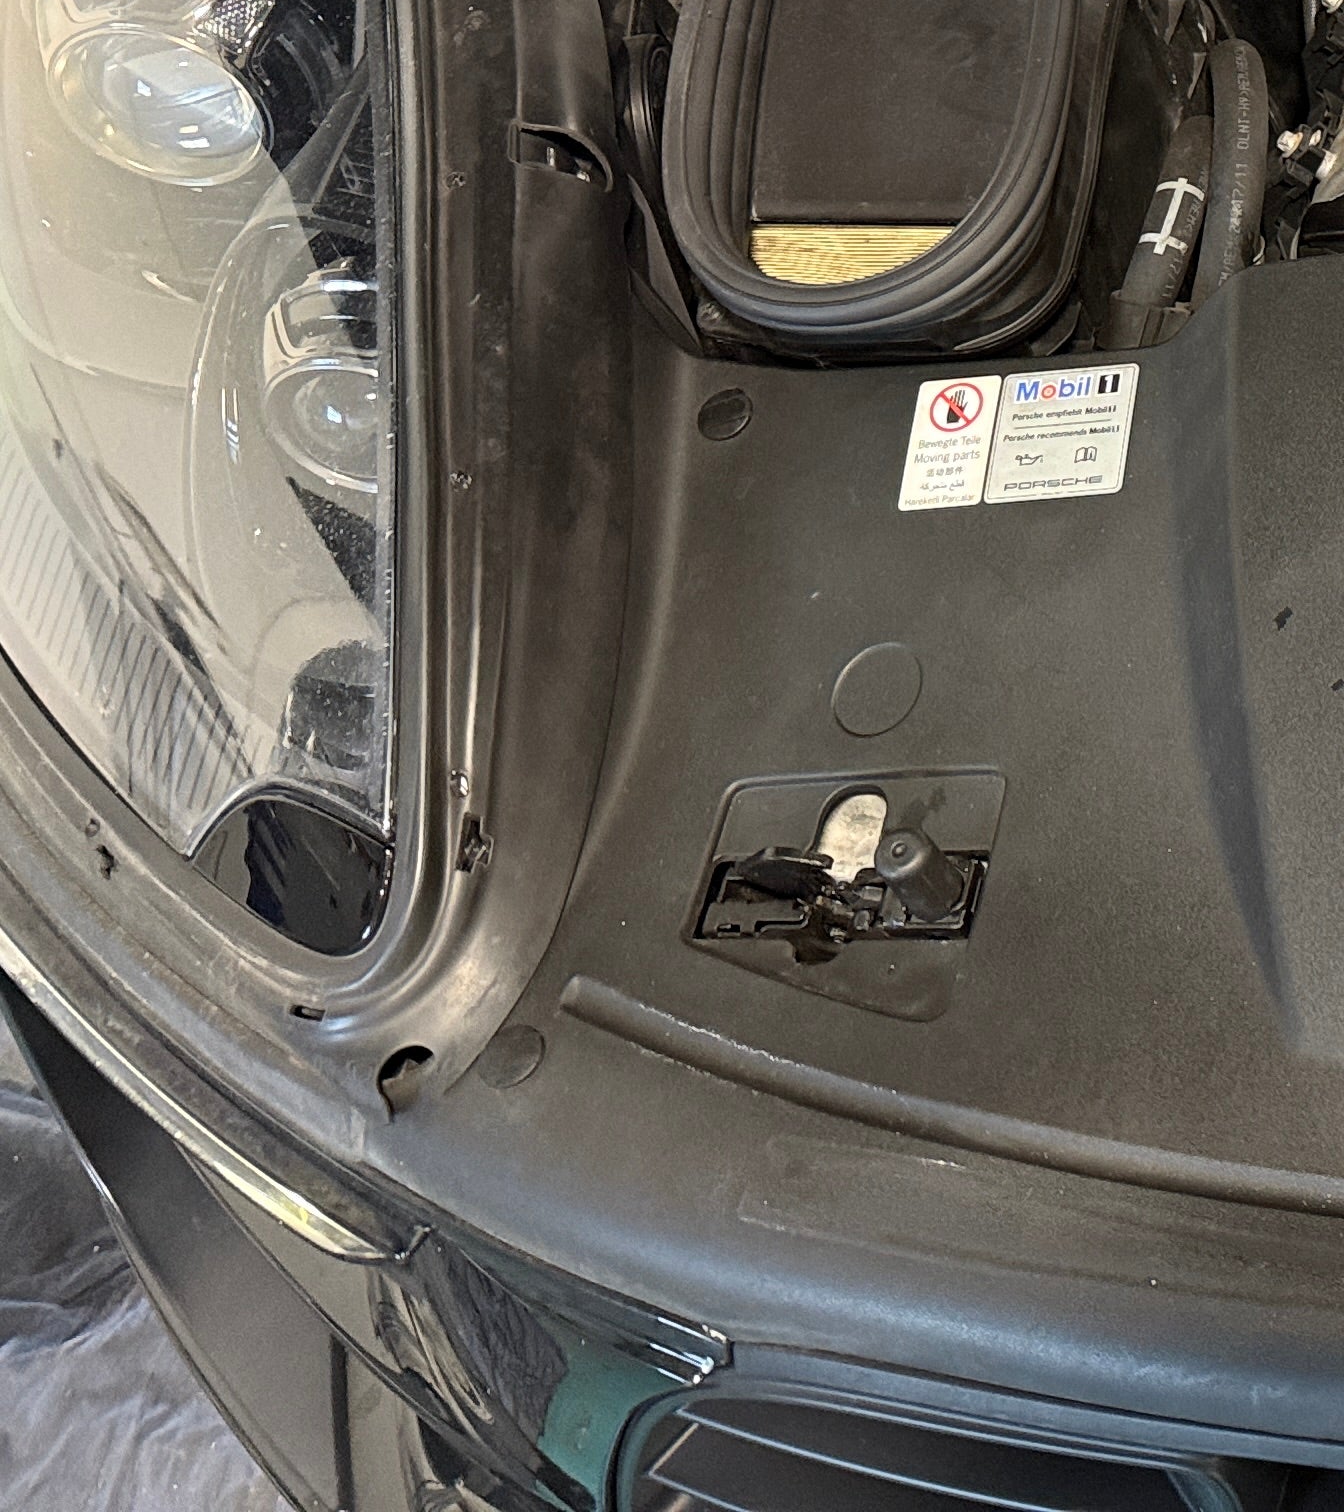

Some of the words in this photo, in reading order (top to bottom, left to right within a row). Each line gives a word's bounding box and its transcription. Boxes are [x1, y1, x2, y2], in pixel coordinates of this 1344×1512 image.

[1016, 376, 1092, 402] Mobil
[1011, 411, 1044, 422] Porsche
[917, 438, 959, 450] Bewegte
[961, 435, 982, 446] Teile
[1003, 433, 1035, 443] Porsche
[913, 452, 951, 464] Moving
[952, 450, 981, 462] parts
[1003, 474, 1103, 492] PORSCHE
